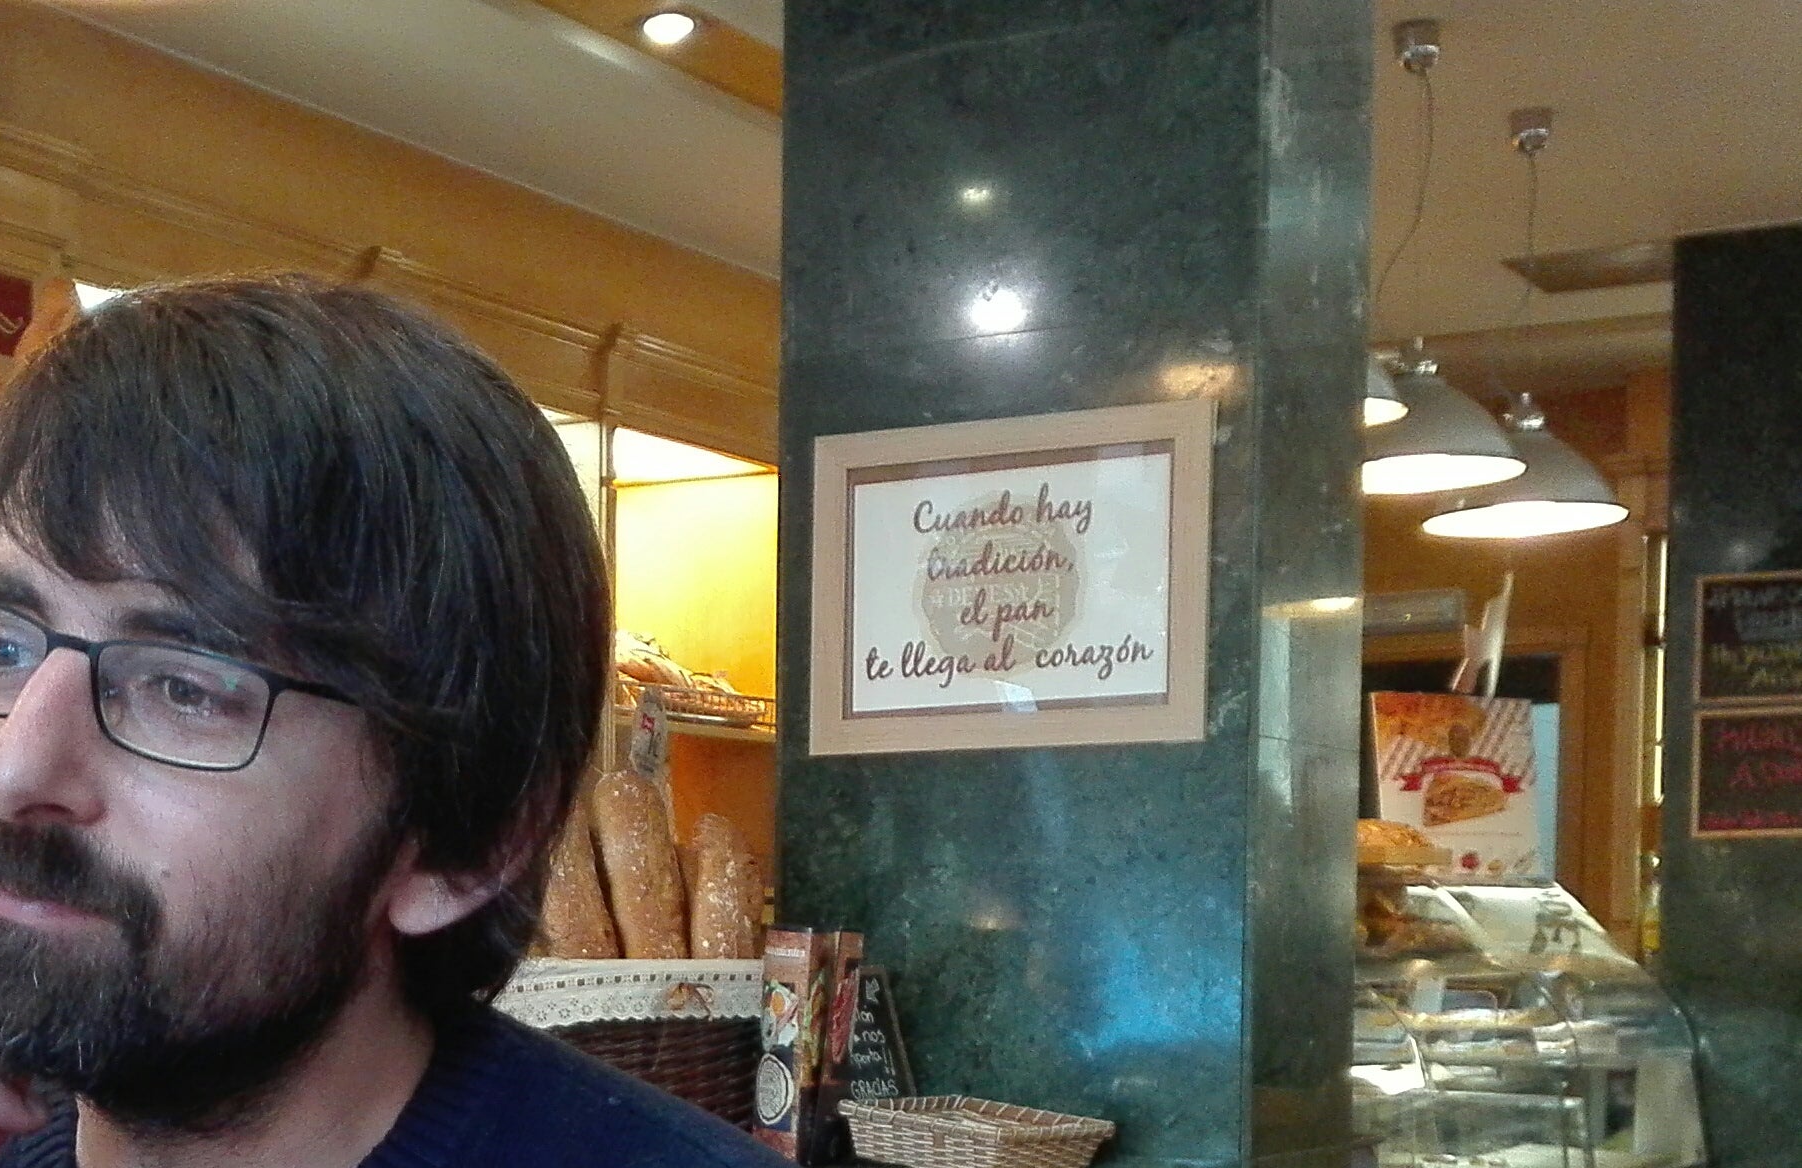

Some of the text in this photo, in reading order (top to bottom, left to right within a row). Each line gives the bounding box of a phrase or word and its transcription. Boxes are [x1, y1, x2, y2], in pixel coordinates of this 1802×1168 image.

[913, 482, 1093, 534] Cuando hay
[927, 540, 1074, 582] tradición,
[960, 588, 1056, 643] el pan
[865, 633, 1155, 689] te llega al corazón
